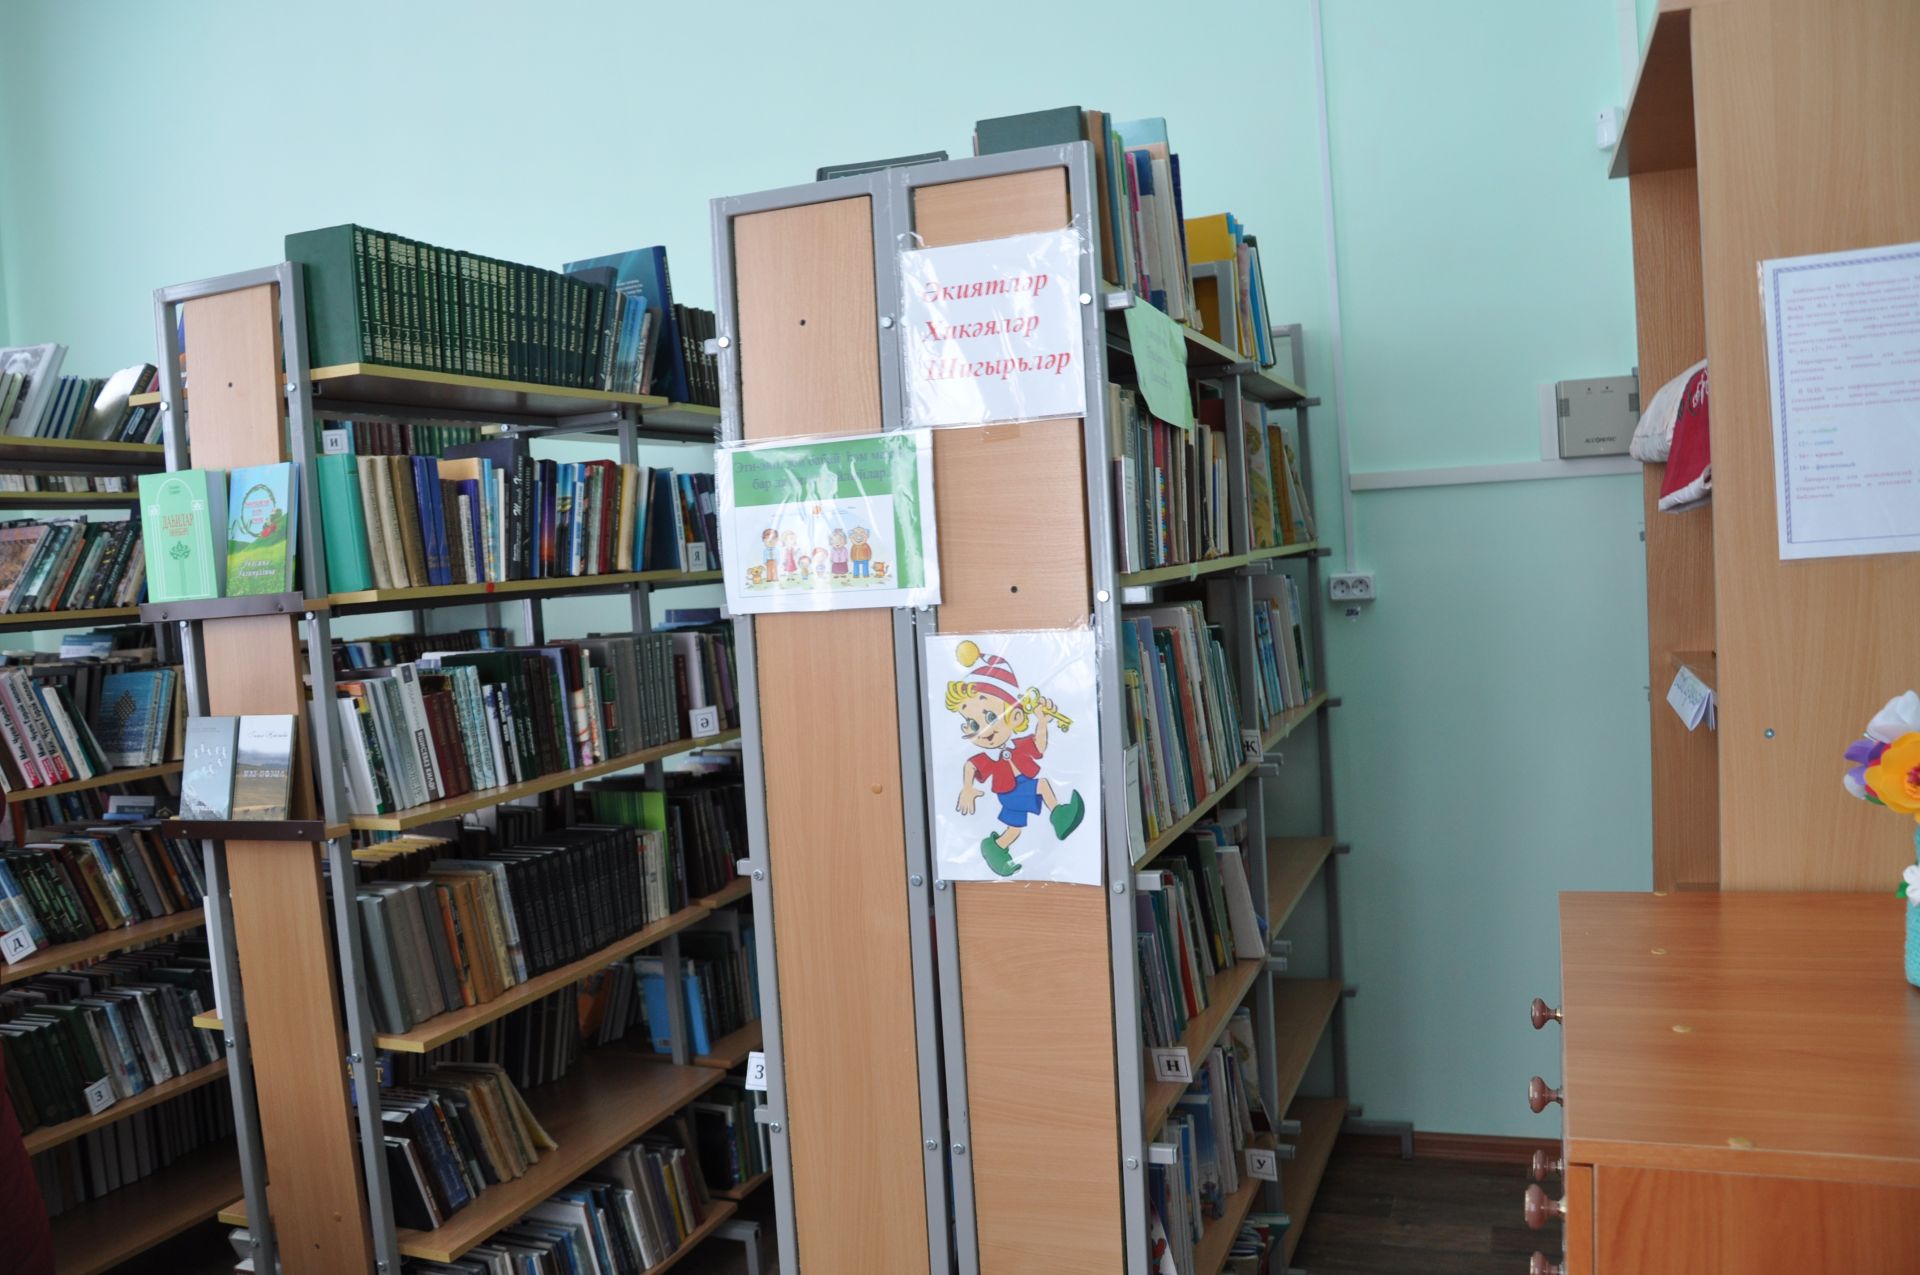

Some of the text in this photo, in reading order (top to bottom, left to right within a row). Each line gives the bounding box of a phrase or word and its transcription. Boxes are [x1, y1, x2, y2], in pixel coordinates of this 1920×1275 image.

[923, 273, 1048, 303] Әкиятләр
[922, 315, 1040, 342] Хикәяләр
[925, 351, 1071, 381] Шигырьләр
[12, 937, 25, 953] Д
[1165, 1060, 1181, 1072] Н
